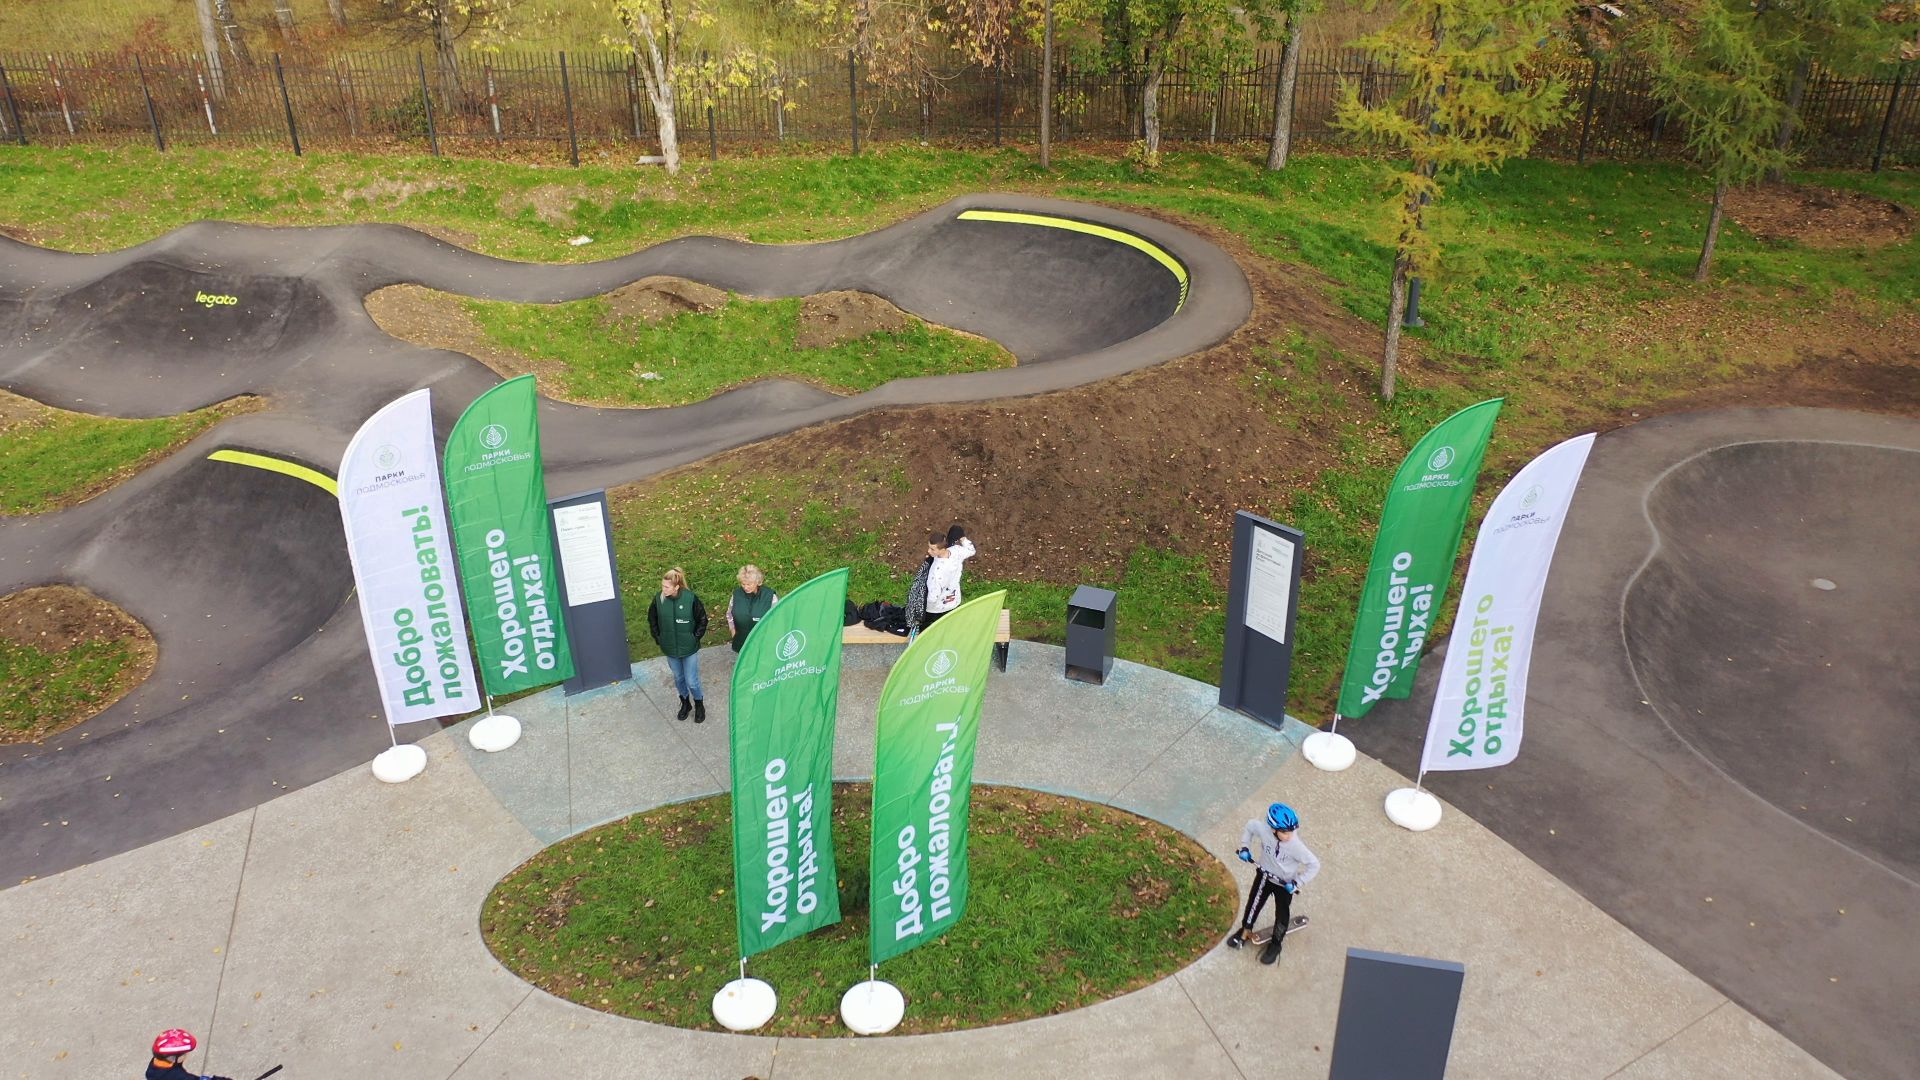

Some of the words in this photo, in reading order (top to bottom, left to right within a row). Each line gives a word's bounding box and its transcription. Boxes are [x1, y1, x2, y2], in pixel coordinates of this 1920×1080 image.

[195, 290, 238, 308] legato
[356, 472, 426, 496] ПОДМОСКОВЬЯ
[375, 470, 405, 483] ПАРКИ
[464, 451, 532, 473] ПОДМОСКОВЬЯ
[481, 448, 511, 461] ПАРКИ
[1421, 473, 1450, 482] ПАРКИ
[401, 505, 463, 700] пожаловать!
[485, 528, 529, 679] Хорошего
[512, 553, 556, 671] отдыха!
[1361, 551, 1412, 705] Хорошего
[393, 608, 436, 708] Добро
[774, 659, 806, 677] ПАРКИ
[899, 684, 970, 707] ПОДМОСКОВЬ
[922, 677, 956, 693] ПАРКИ
[1447, 593, 1494, 758] Хорошего
[1483, 625, 1514, 756] отдыха!
[761, 757, 795, 933] Хорошего
[792, 782, 819, 915] отдыха!
[892, 824, 923, 941] Добро
